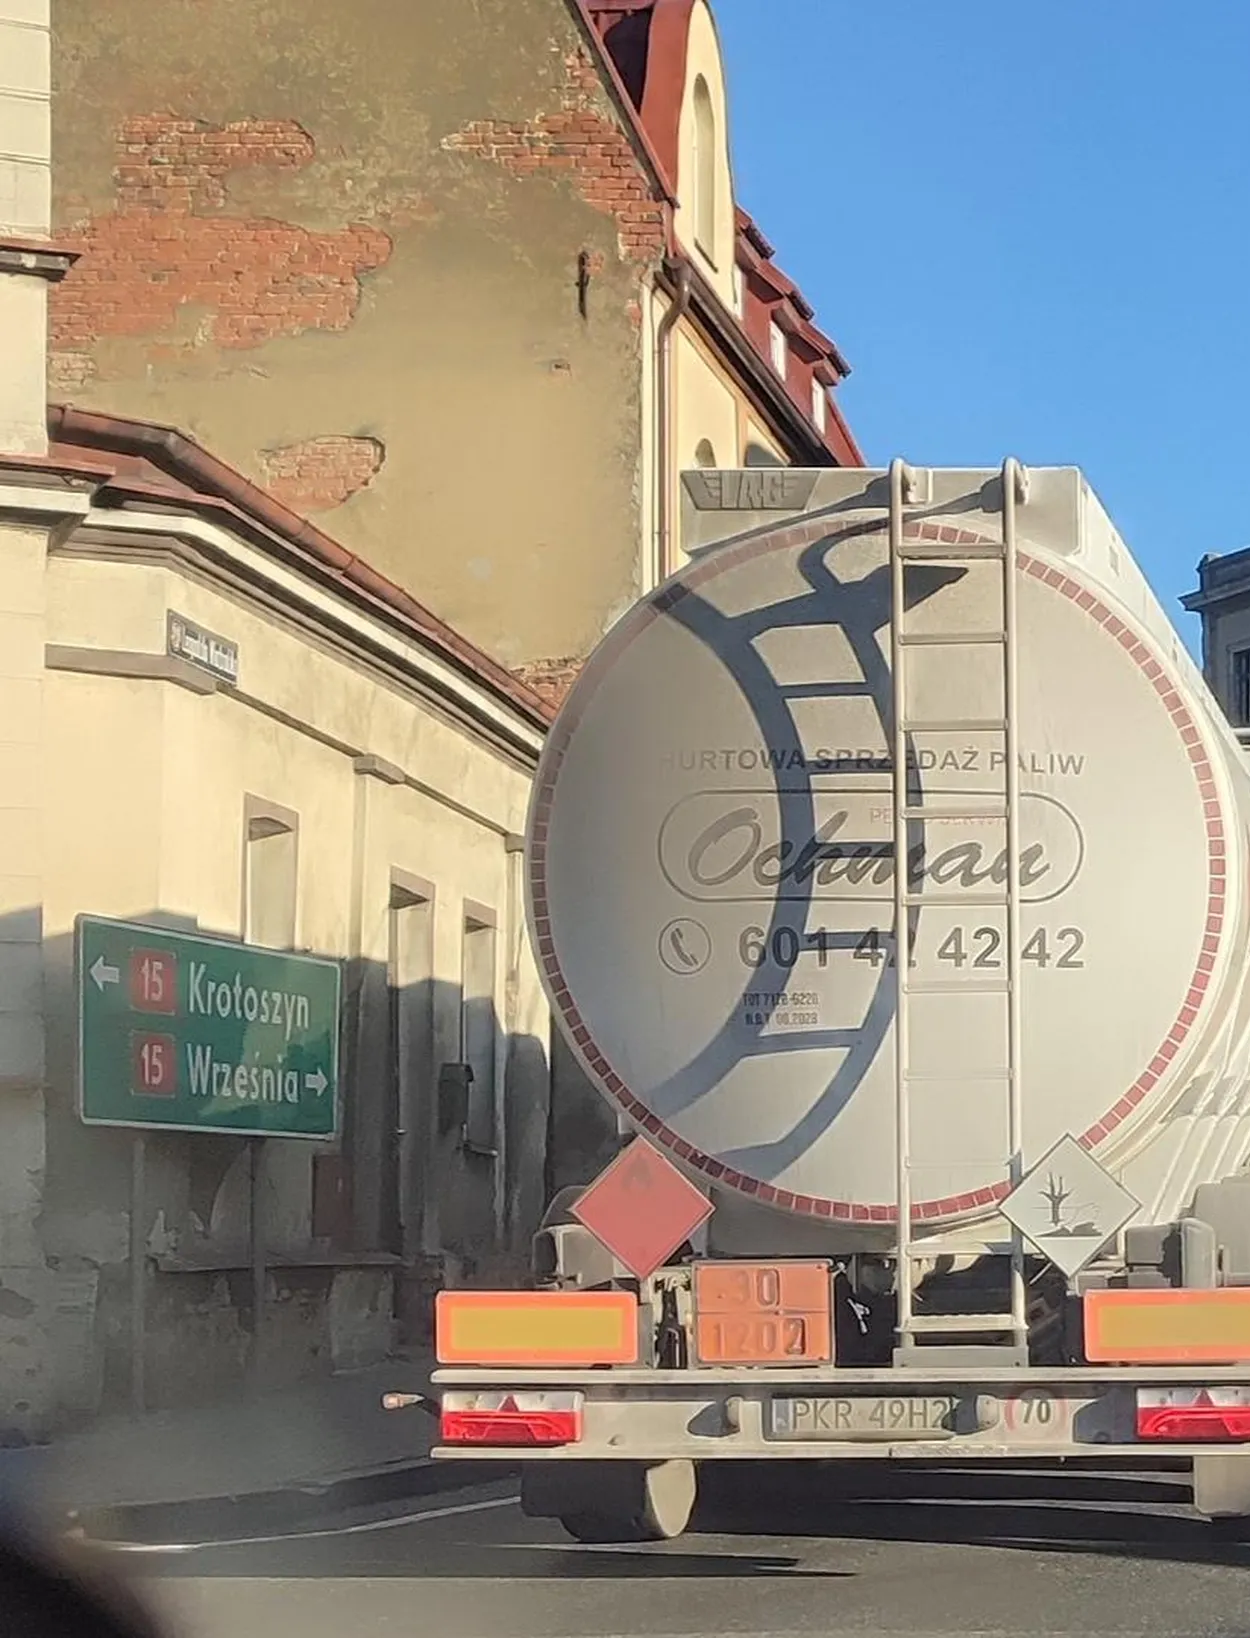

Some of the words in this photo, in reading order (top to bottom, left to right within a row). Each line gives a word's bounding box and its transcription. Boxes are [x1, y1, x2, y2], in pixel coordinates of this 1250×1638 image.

[661, 750, 806, 771] HURTOWA
[815, 745, 980, 771] SPRZEDAŻ
[989, 751, 1085, 776] PALIW
[687, 806, 1051, 888] Ochman
[739, 926, 828, 969] 601
[937, 926, 1001, 969] 42
[1020, 926, 1085, 969] 42
[140, 957, 163, 1001] 15
[188, 961, 309, 1041] Krotoszyn
[140, 1042, 163, 1086] 15
[186, 1042, 299, 1103] Września
[713, 1318, 806, 1357] 1202
[792, 1399, 852, 1429] PKR
[868, 1399, 948, 1429] 49H2
[1020, 1399, 1052, 1425] 70
